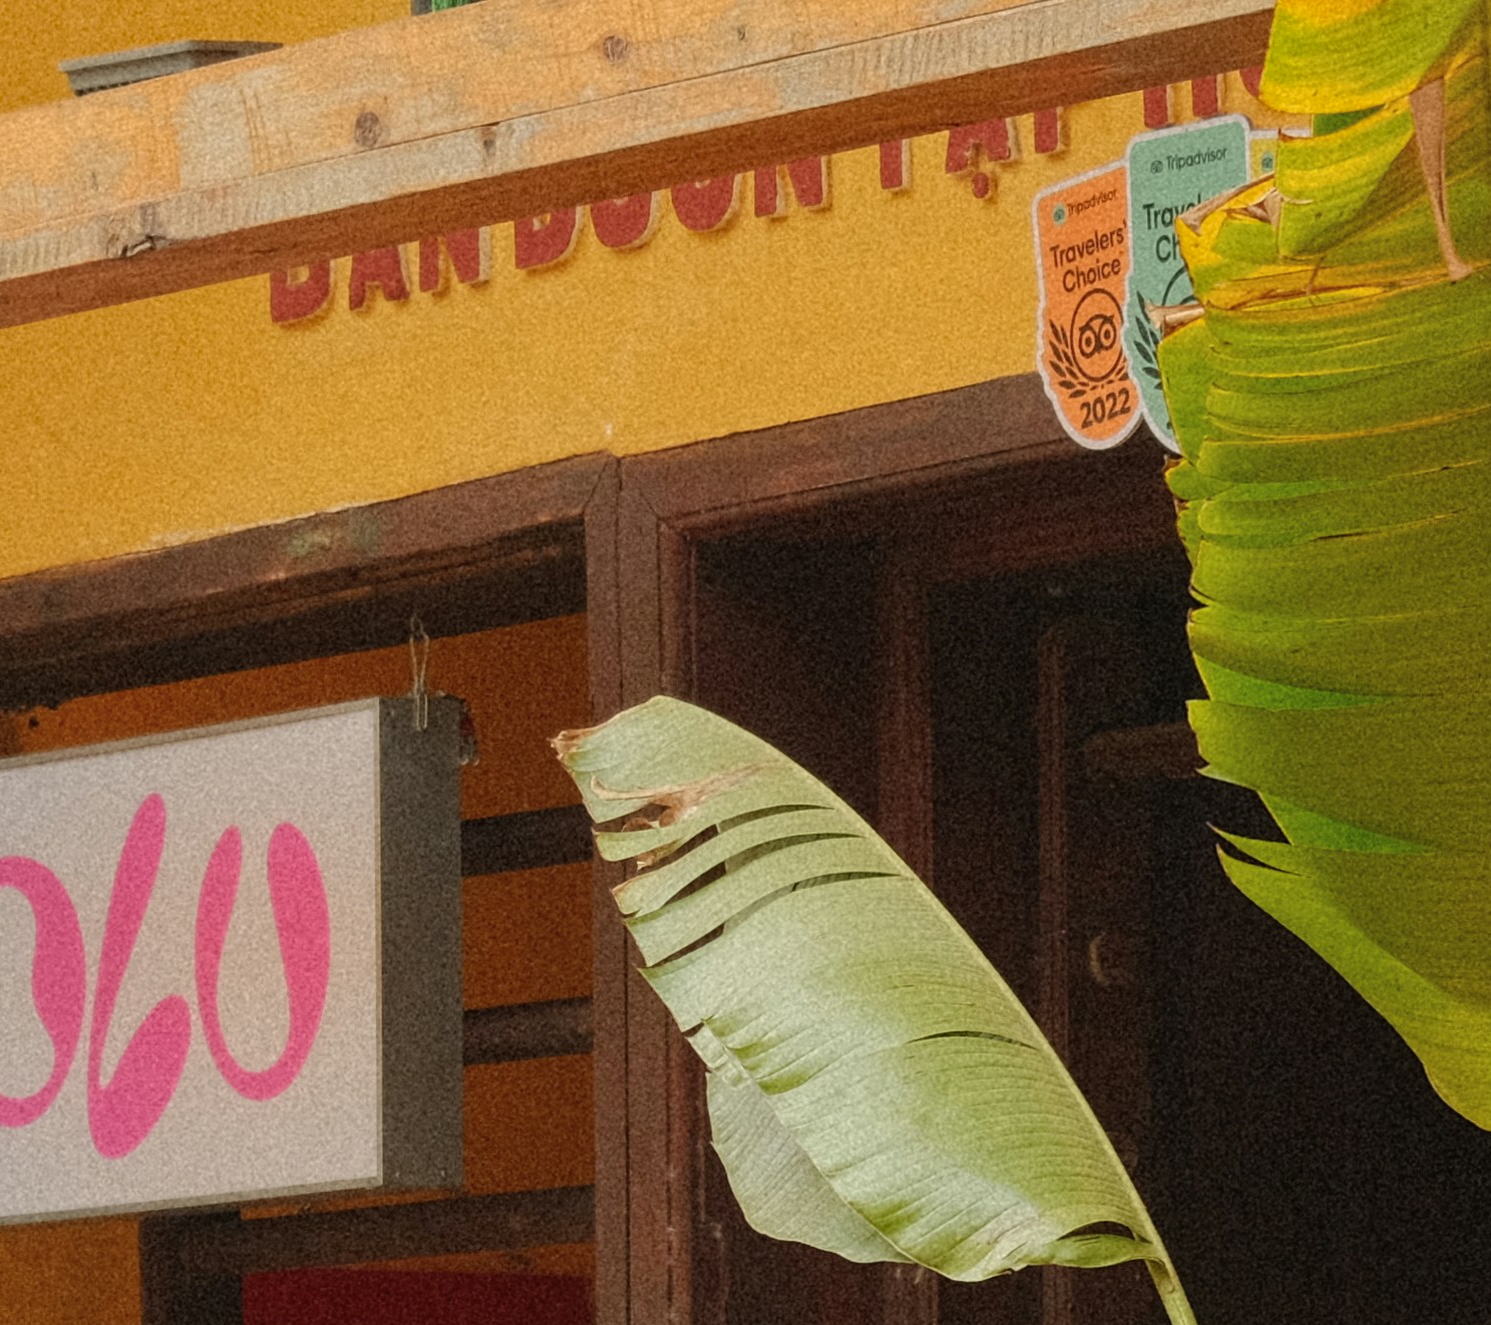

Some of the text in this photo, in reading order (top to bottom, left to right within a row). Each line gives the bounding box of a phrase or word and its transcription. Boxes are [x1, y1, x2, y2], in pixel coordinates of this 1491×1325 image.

[1167, 146, 1227, 171] Tripadvisor
[1066, 187, 1118, 218] Tripadvisor
[1049, 219, 1128, 269] Travelers'
[1062, 257, 1121, 293] Choice
[1080, 387, 1132, 429] 2022
